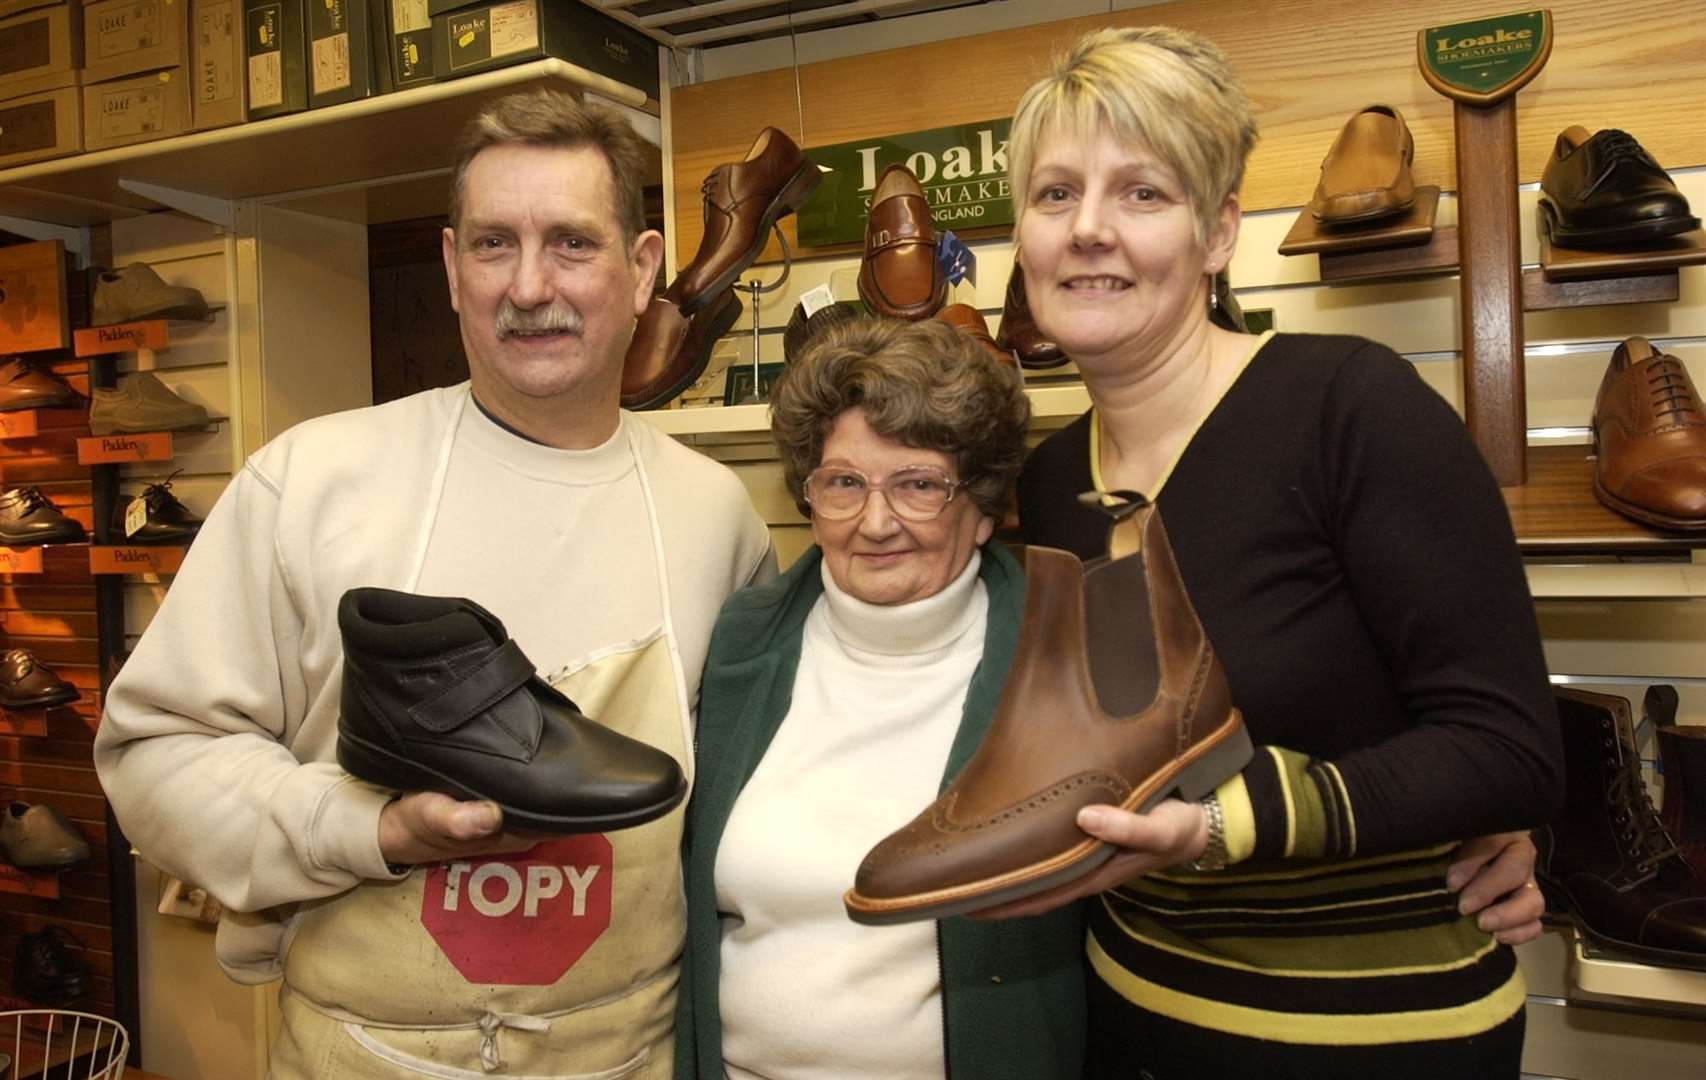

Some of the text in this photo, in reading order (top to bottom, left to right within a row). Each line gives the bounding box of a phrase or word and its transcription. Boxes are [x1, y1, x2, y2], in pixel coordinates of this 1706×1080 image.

[100, 15, 126, 32] LOAKE
[453, 19, 486, 34] Loake
[1436, 29, 1532, 52] Loake
[205, 59, 216, 100] LOAKE
[103, 99, 130, 113] LOAKE
[856, 130, 1009, 192] Loak
[931, 205, 985, 222] NGLAND
[103, 438, 138, 452] Padders
[443, 862, 600, 918] TOPY
